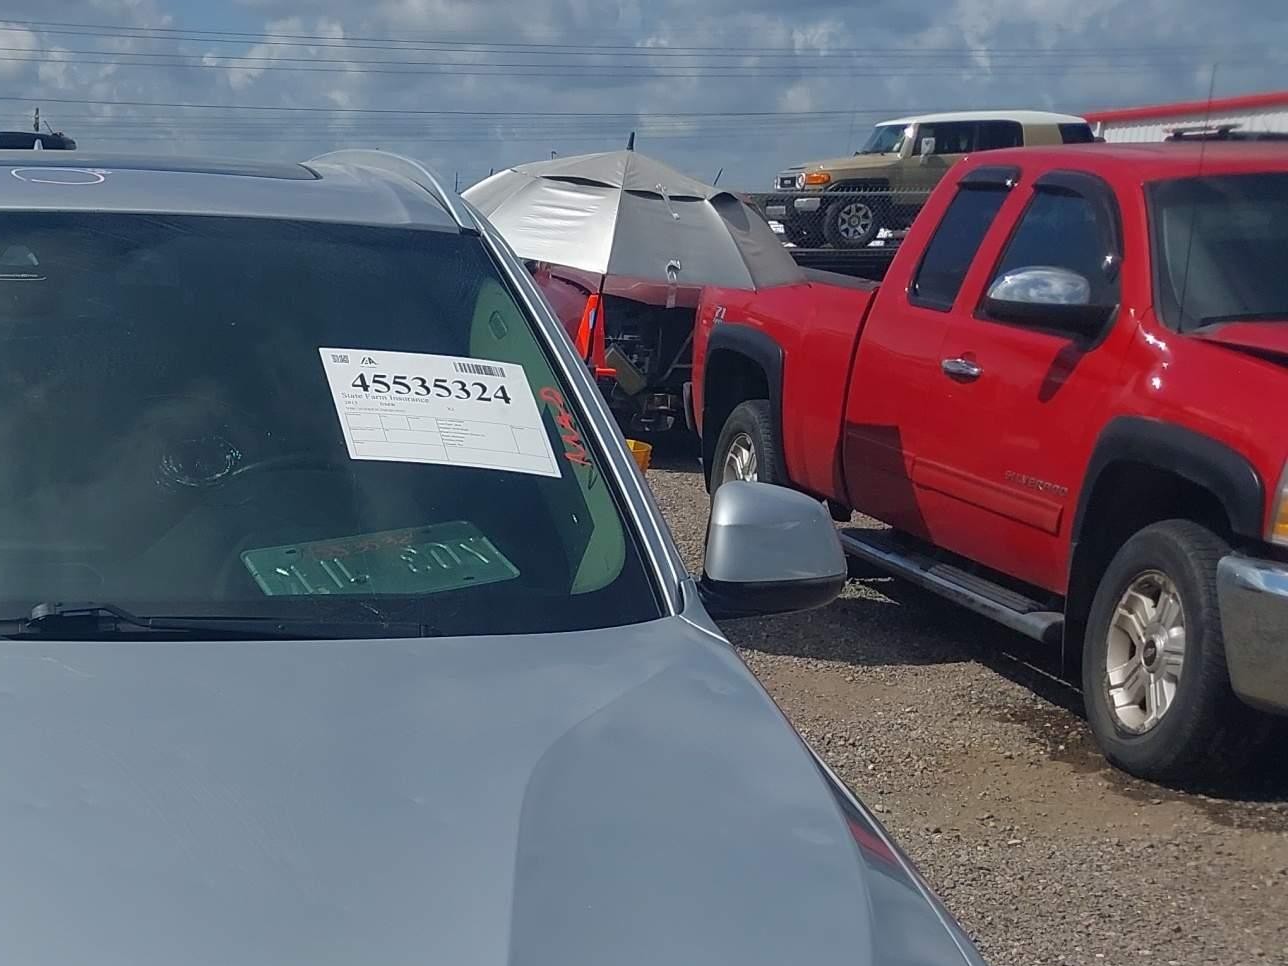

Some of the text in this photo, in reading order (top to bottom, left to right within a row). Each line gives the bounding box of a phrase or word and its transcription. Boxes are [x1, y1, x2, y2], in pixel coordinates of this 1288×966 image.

[351, 372, 512, 405] 45535324
[365, 393, 388, 401] Farm
[390, 394, 430, 404] Insurance
